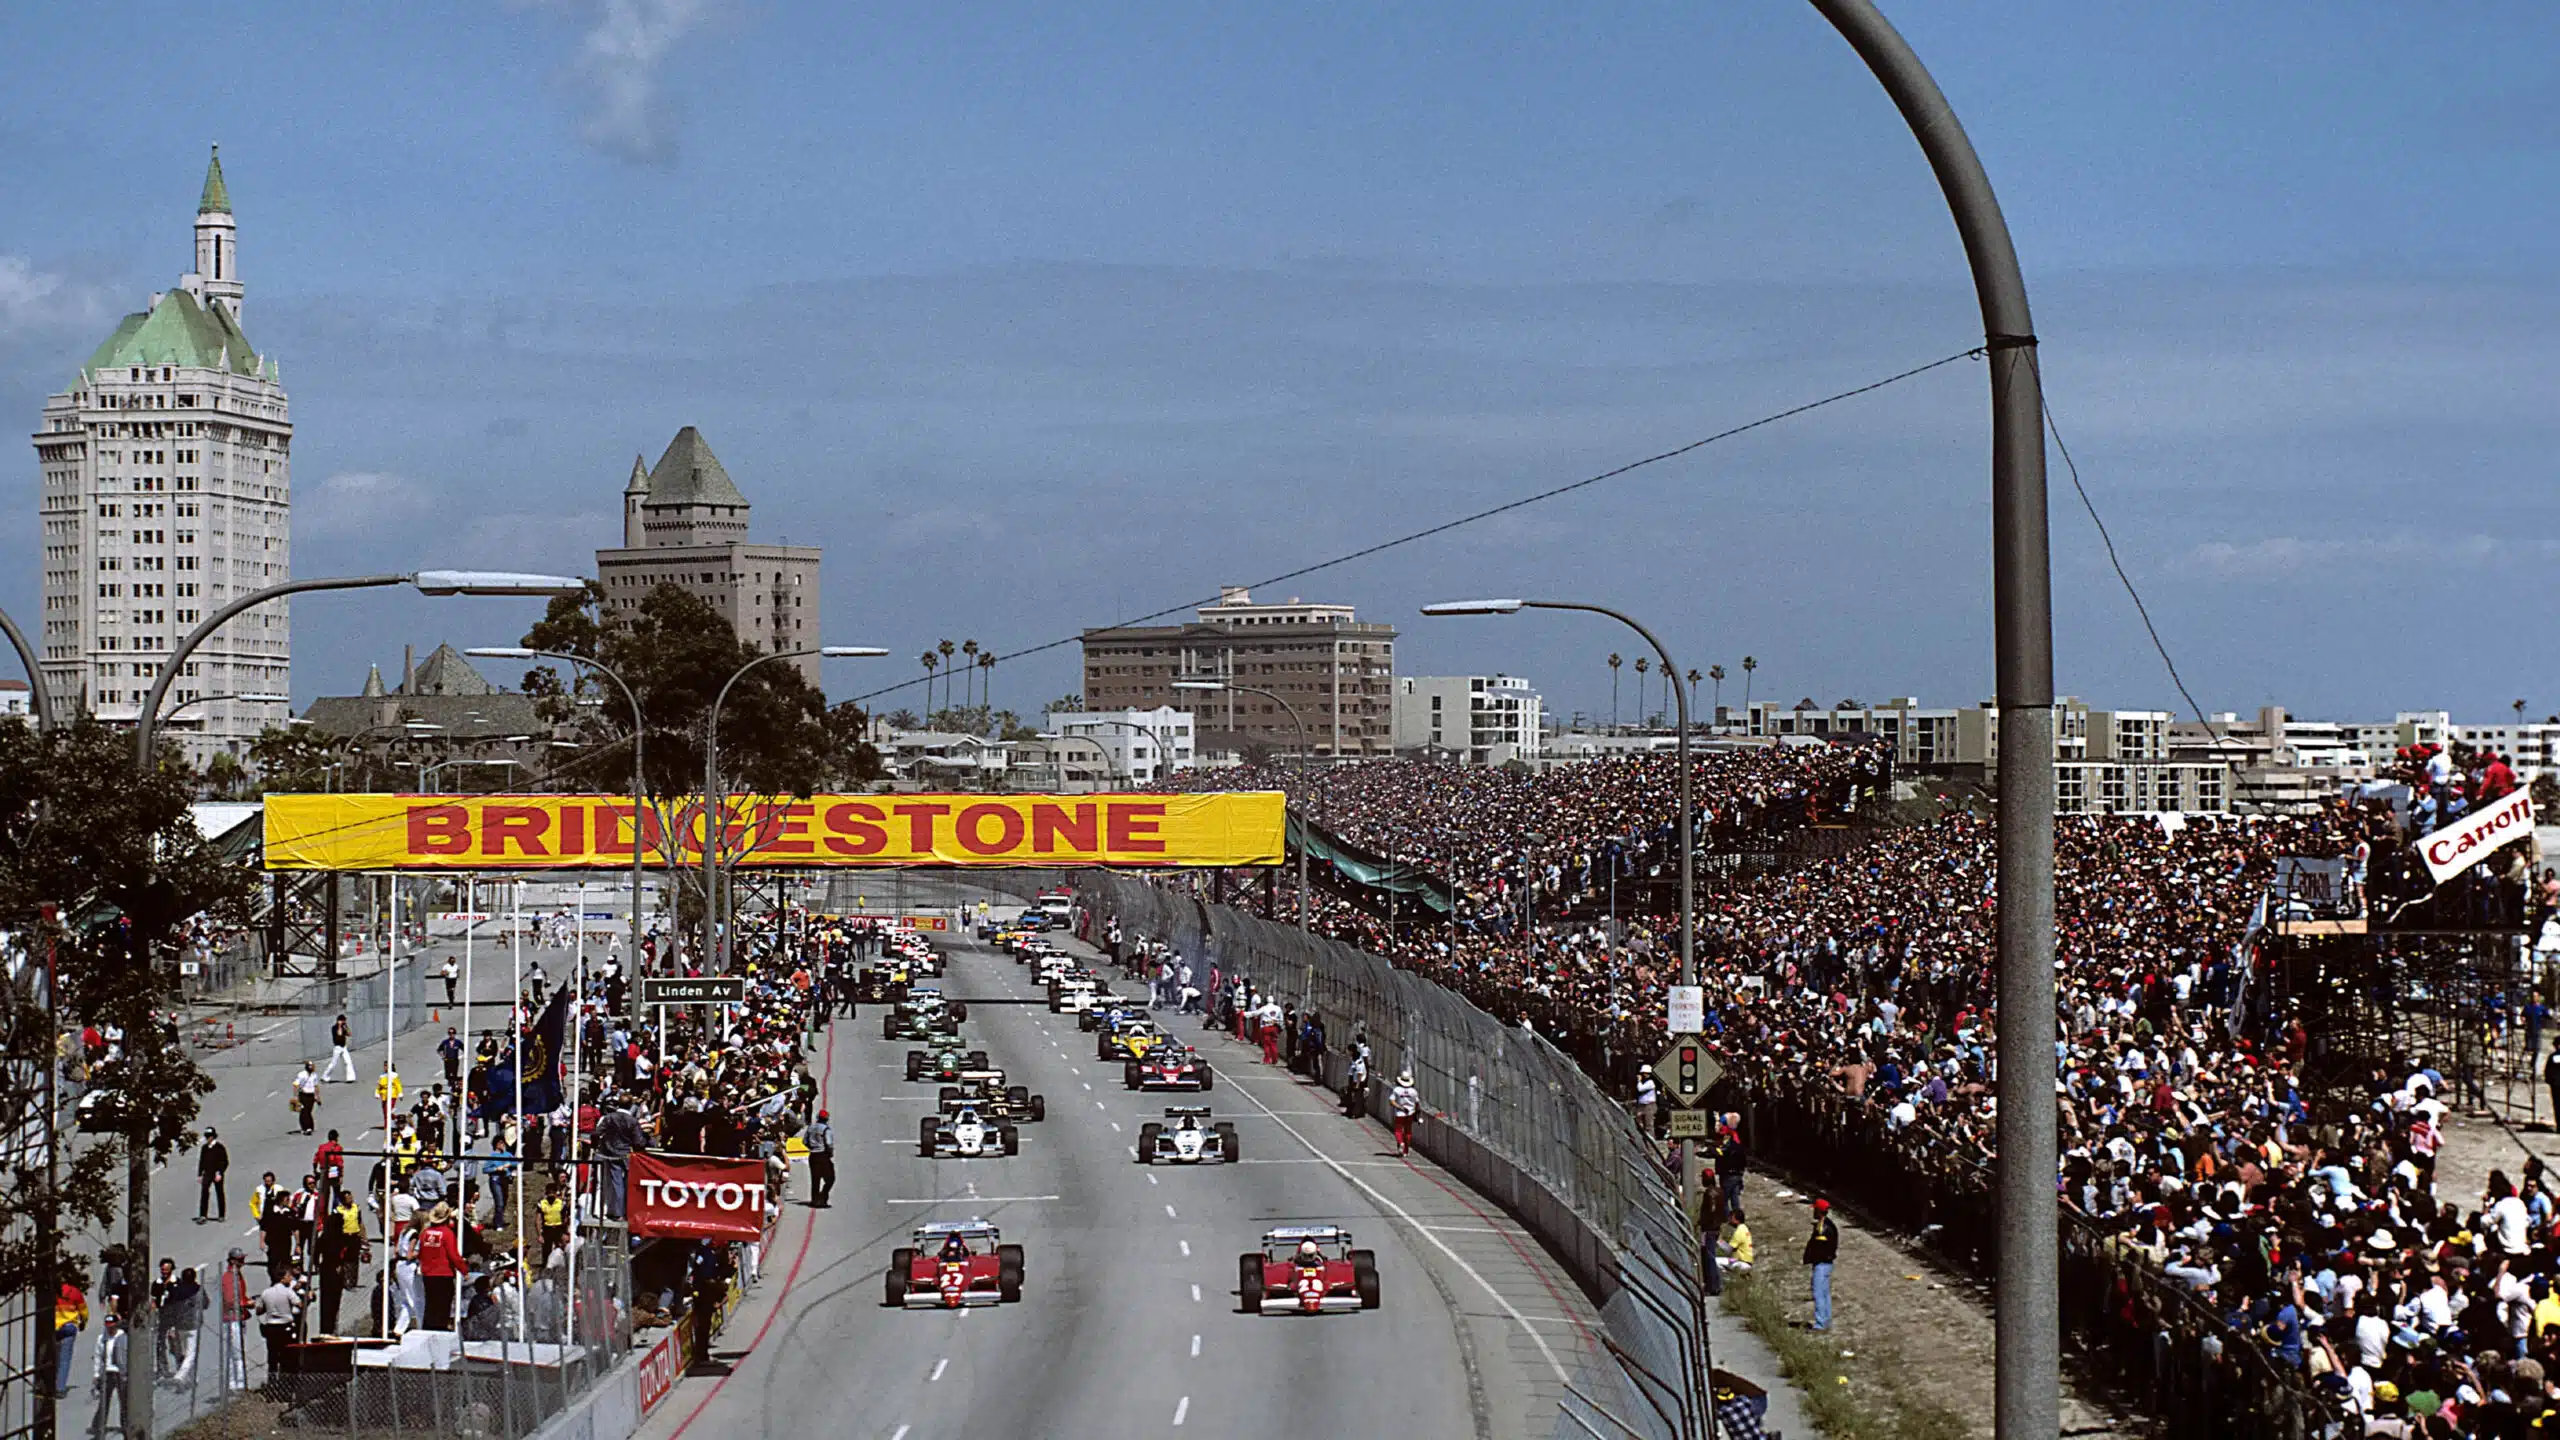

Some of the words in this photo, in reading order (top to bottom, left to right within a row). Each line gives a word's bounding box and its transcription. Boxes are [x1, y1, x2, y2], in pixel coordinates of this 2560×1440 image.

[407, 802, 1166, 856] BRIDGESTONE
[2428, 798, 2531, 866] Canon
[657, 986, 703, 996] Linden
[712, 986, 731, 996] Av
[1674, 1114, 1703, 1122] SIGNAL
[940, 1273, 963, 1288] 27
[1298, 1279, 1323, 1293] 28
